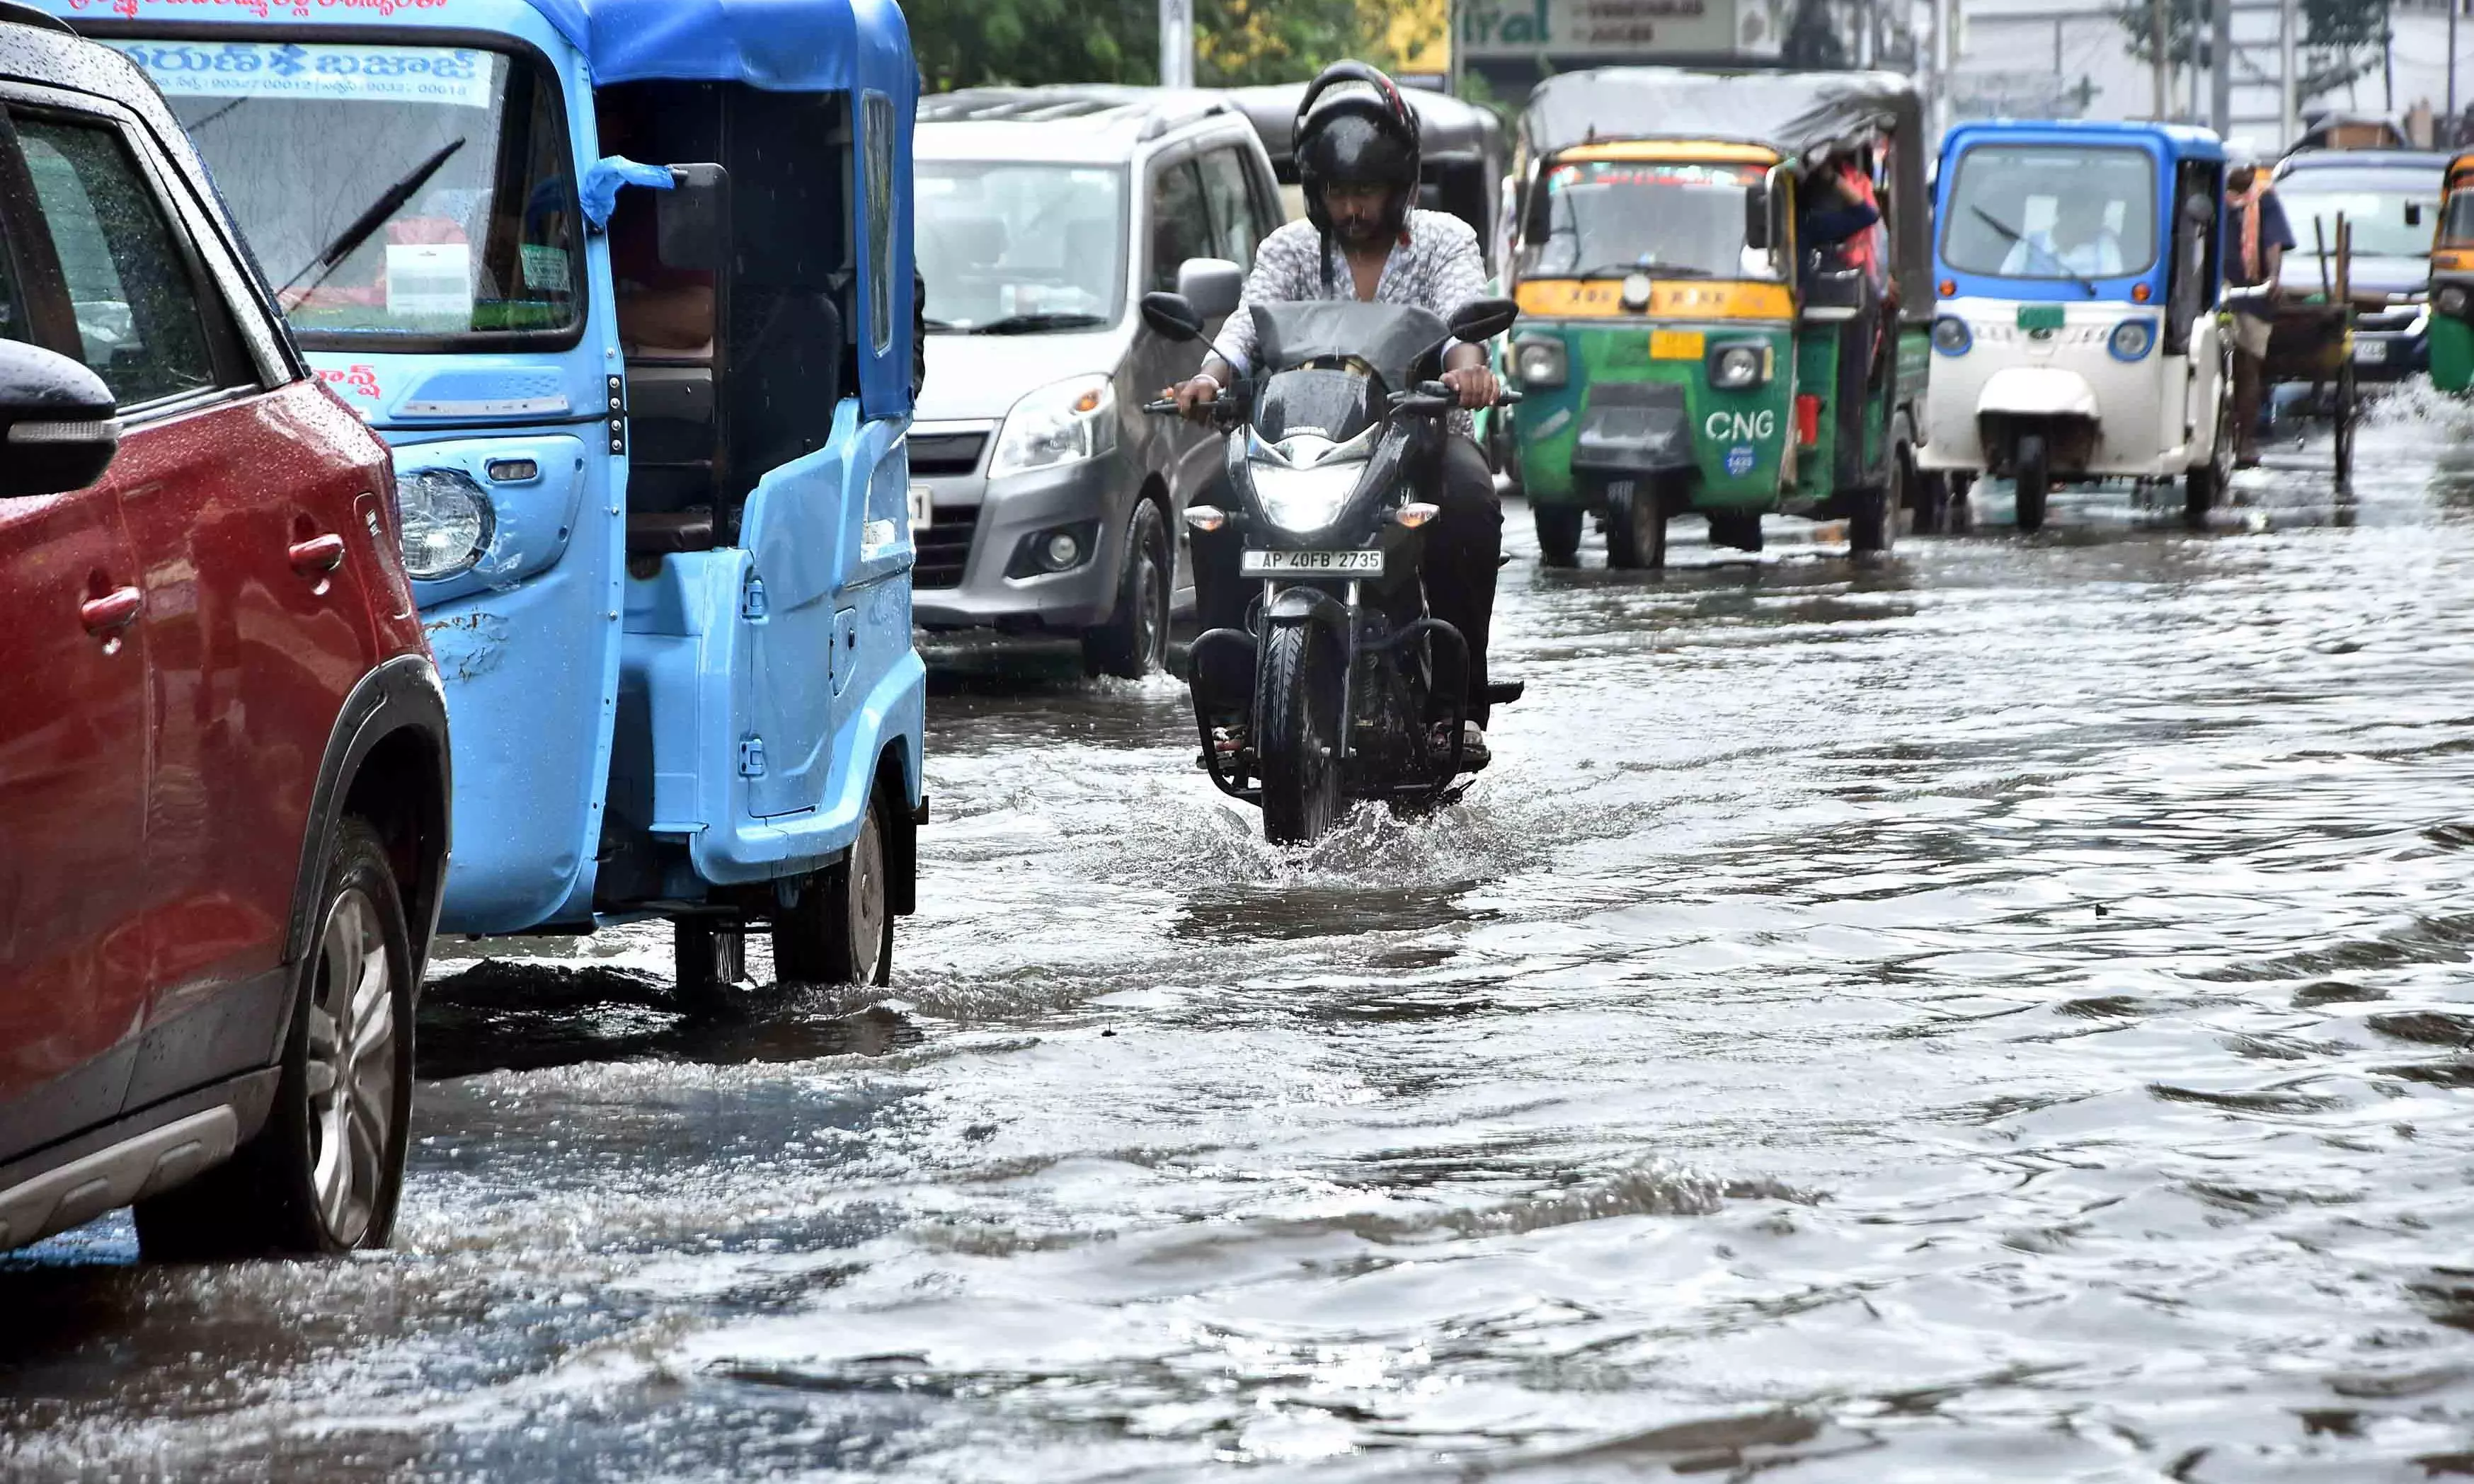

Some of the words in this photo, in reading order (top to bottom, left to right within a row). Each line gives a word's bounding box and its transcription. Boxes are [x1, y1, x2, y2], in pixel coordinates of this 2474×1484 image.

[1705, 410, 1773, 440] CNG
[1263, 553, 1282, 568] AP
[1290, 553, 1331, 568] 40FB
[1339, 553, 1379, 568] 2735
